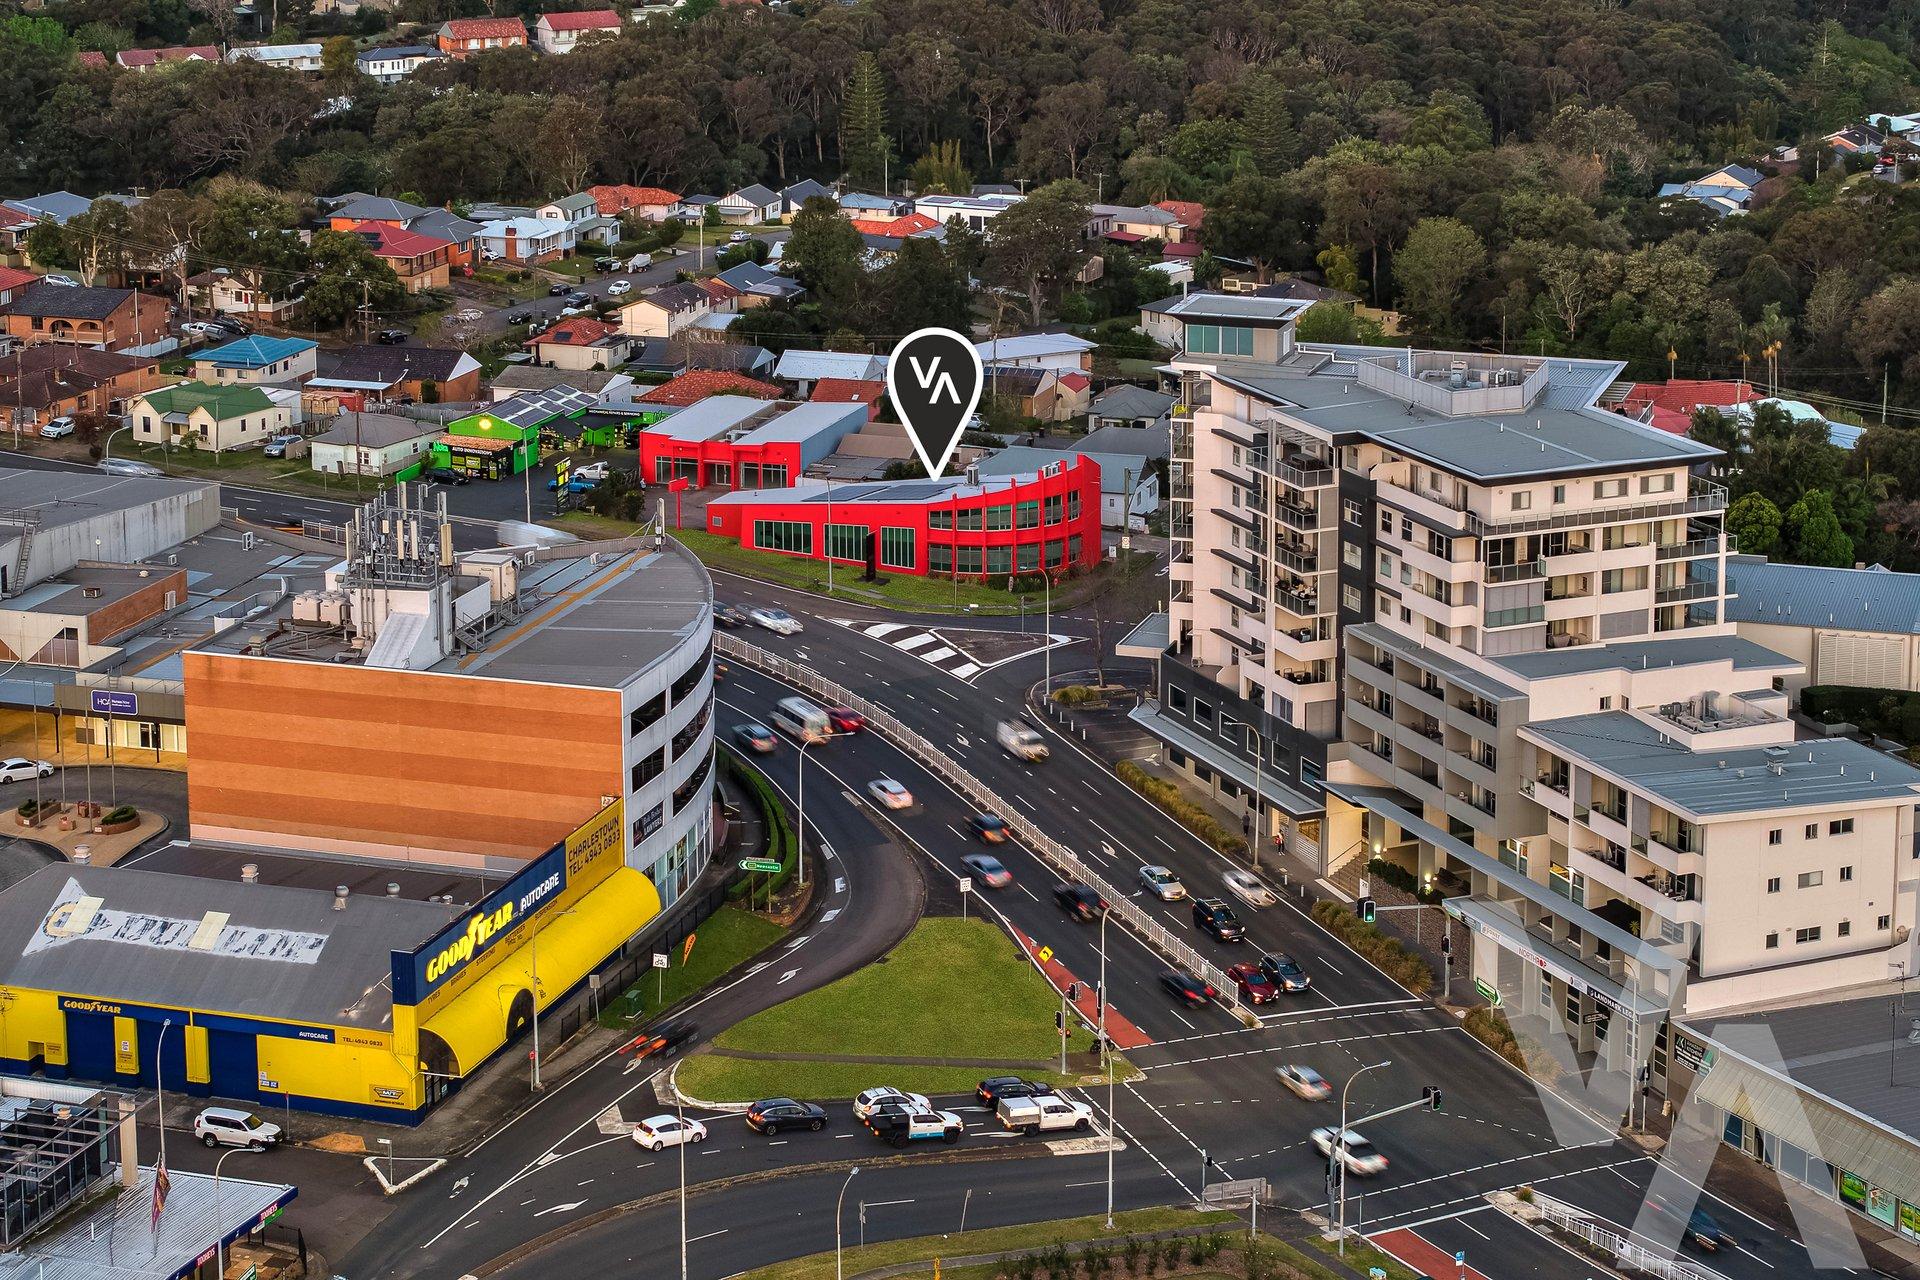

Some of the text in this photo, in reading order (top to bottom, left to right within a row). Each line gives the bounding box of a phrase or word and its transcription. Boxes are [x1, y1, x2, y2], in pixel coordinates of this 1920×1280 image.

[568, 815, 620, 862] CHARLESTOWN
[568, 830, 621, 878] TEL: 4943 0833
[427, 872, 561, 983] GOODYEAR AUTOCARE
[63, 1000, 122, 1014] GOODYEAR
[427, 990, 441, 1005] TYRES
[1594, 992, 1622, 1016] LANDMARK
[298, 1031, 329, 1040] AUTOCARE
[260, 1203, 278, 1220] TOOHEYS
[197, 1247, 216, 1266] TOOHEYS
